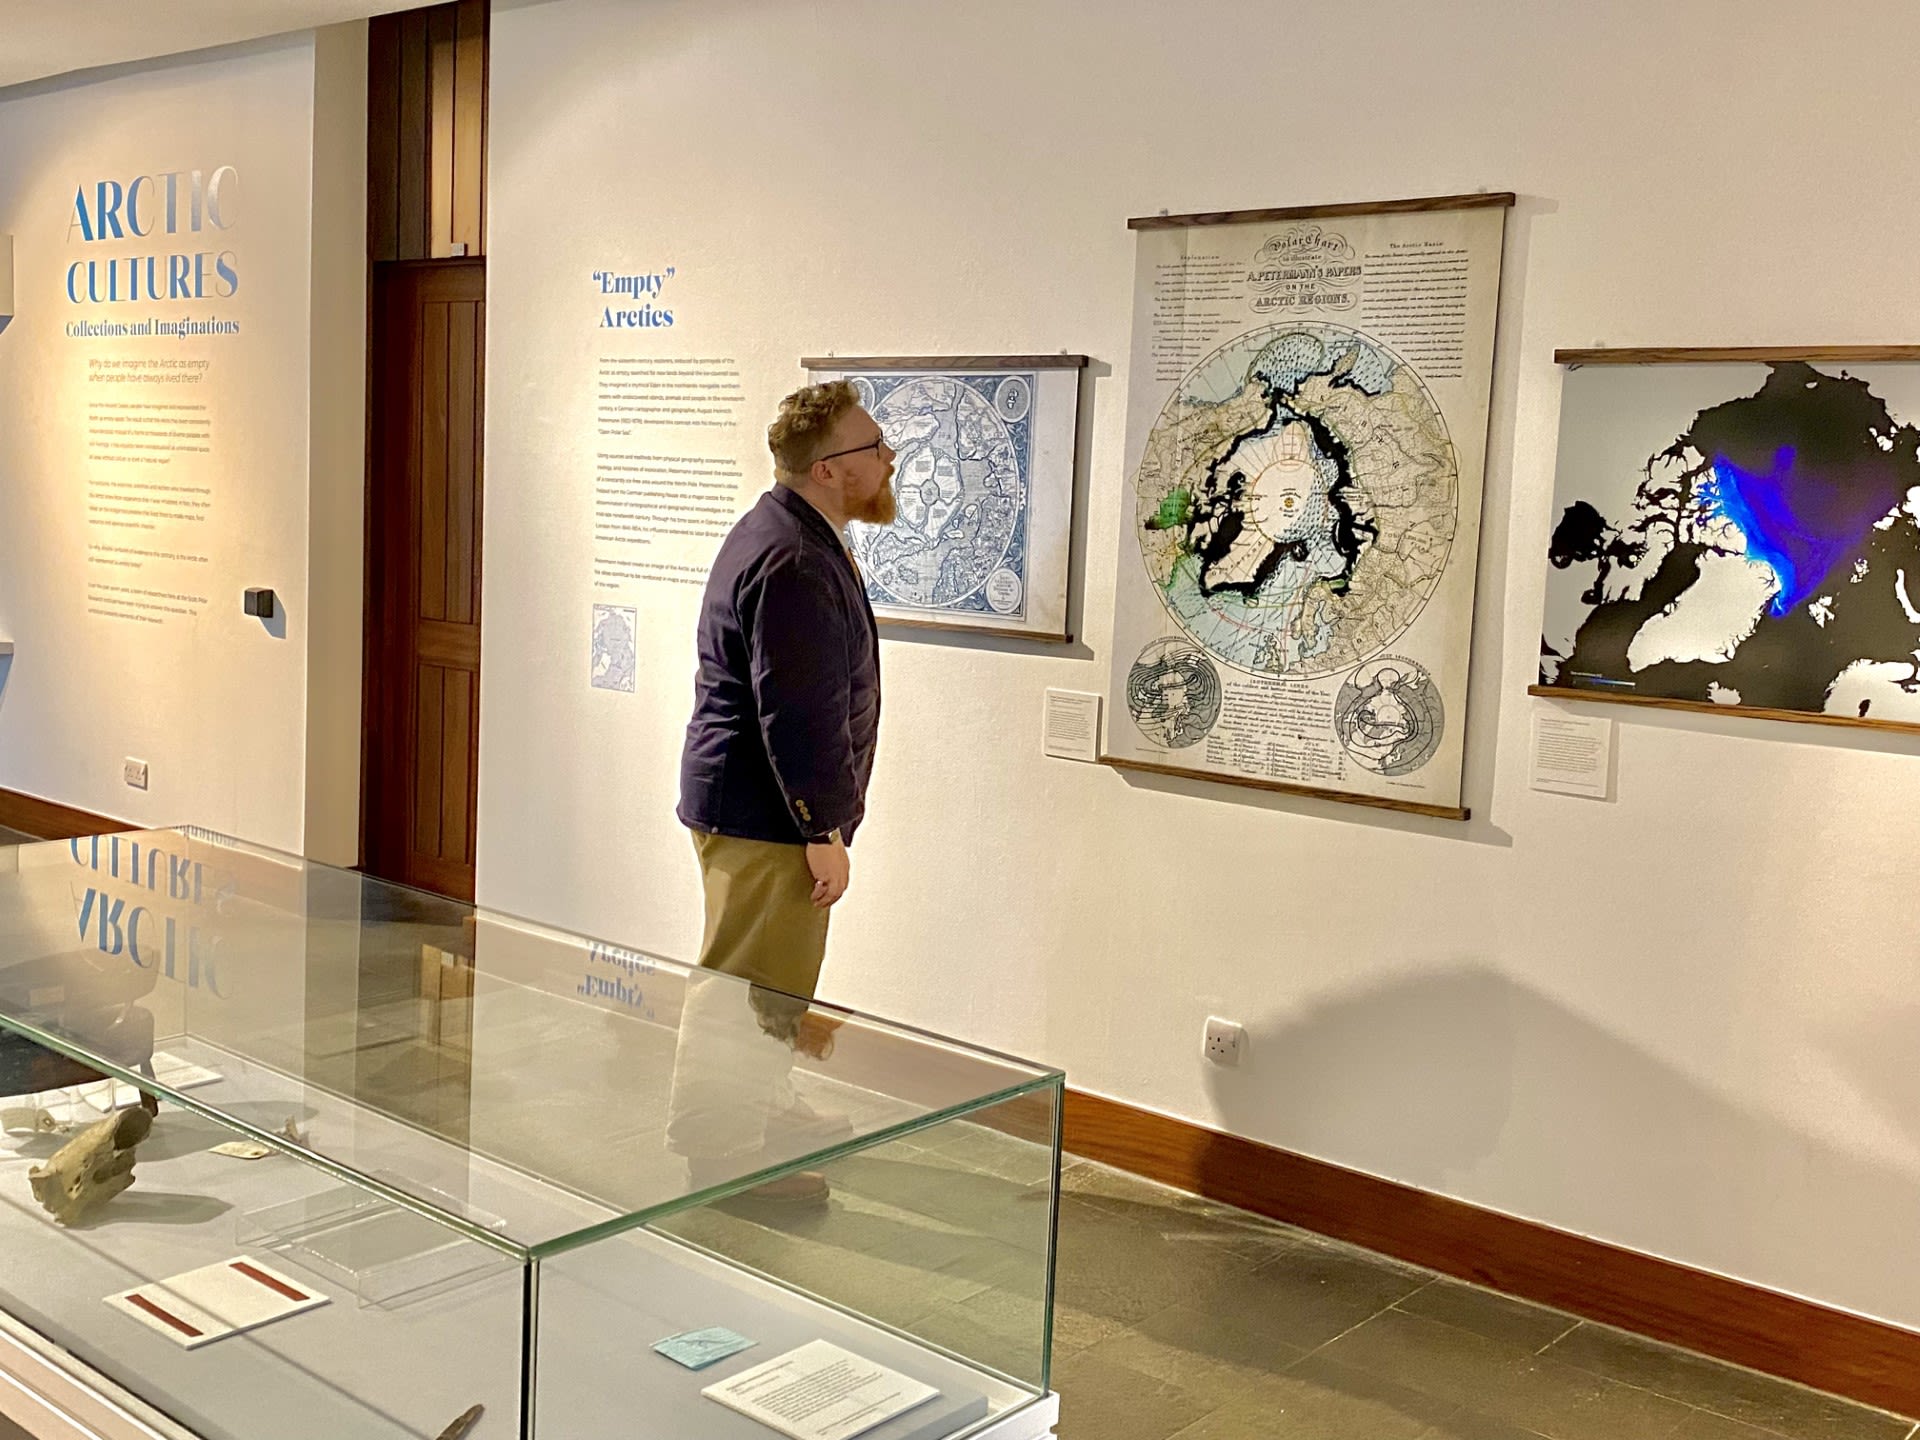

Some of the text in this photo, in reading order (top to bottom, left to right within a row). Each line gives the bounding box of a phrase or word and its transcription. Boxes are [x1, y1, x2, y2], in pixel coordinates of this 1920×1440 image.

[66, 165, 239, 244] ARCTIC
[66, 250, 239, 304] CULTURES
[1326, 266, 1362, 278] PAPERS
[1254, 293, 1351, 307] ARCTIC REGIONS.
[65, 315, 240, 341] Collections and Imaginations
[599, 303, 674, 329] Arctics
[89, 359, 101, 370] Why
[147, 359, 158, 368] the
[159, 359, 178, 369] Arctic
[178, 361, 187, 369] as
[187, 360, 210, 371] empty
